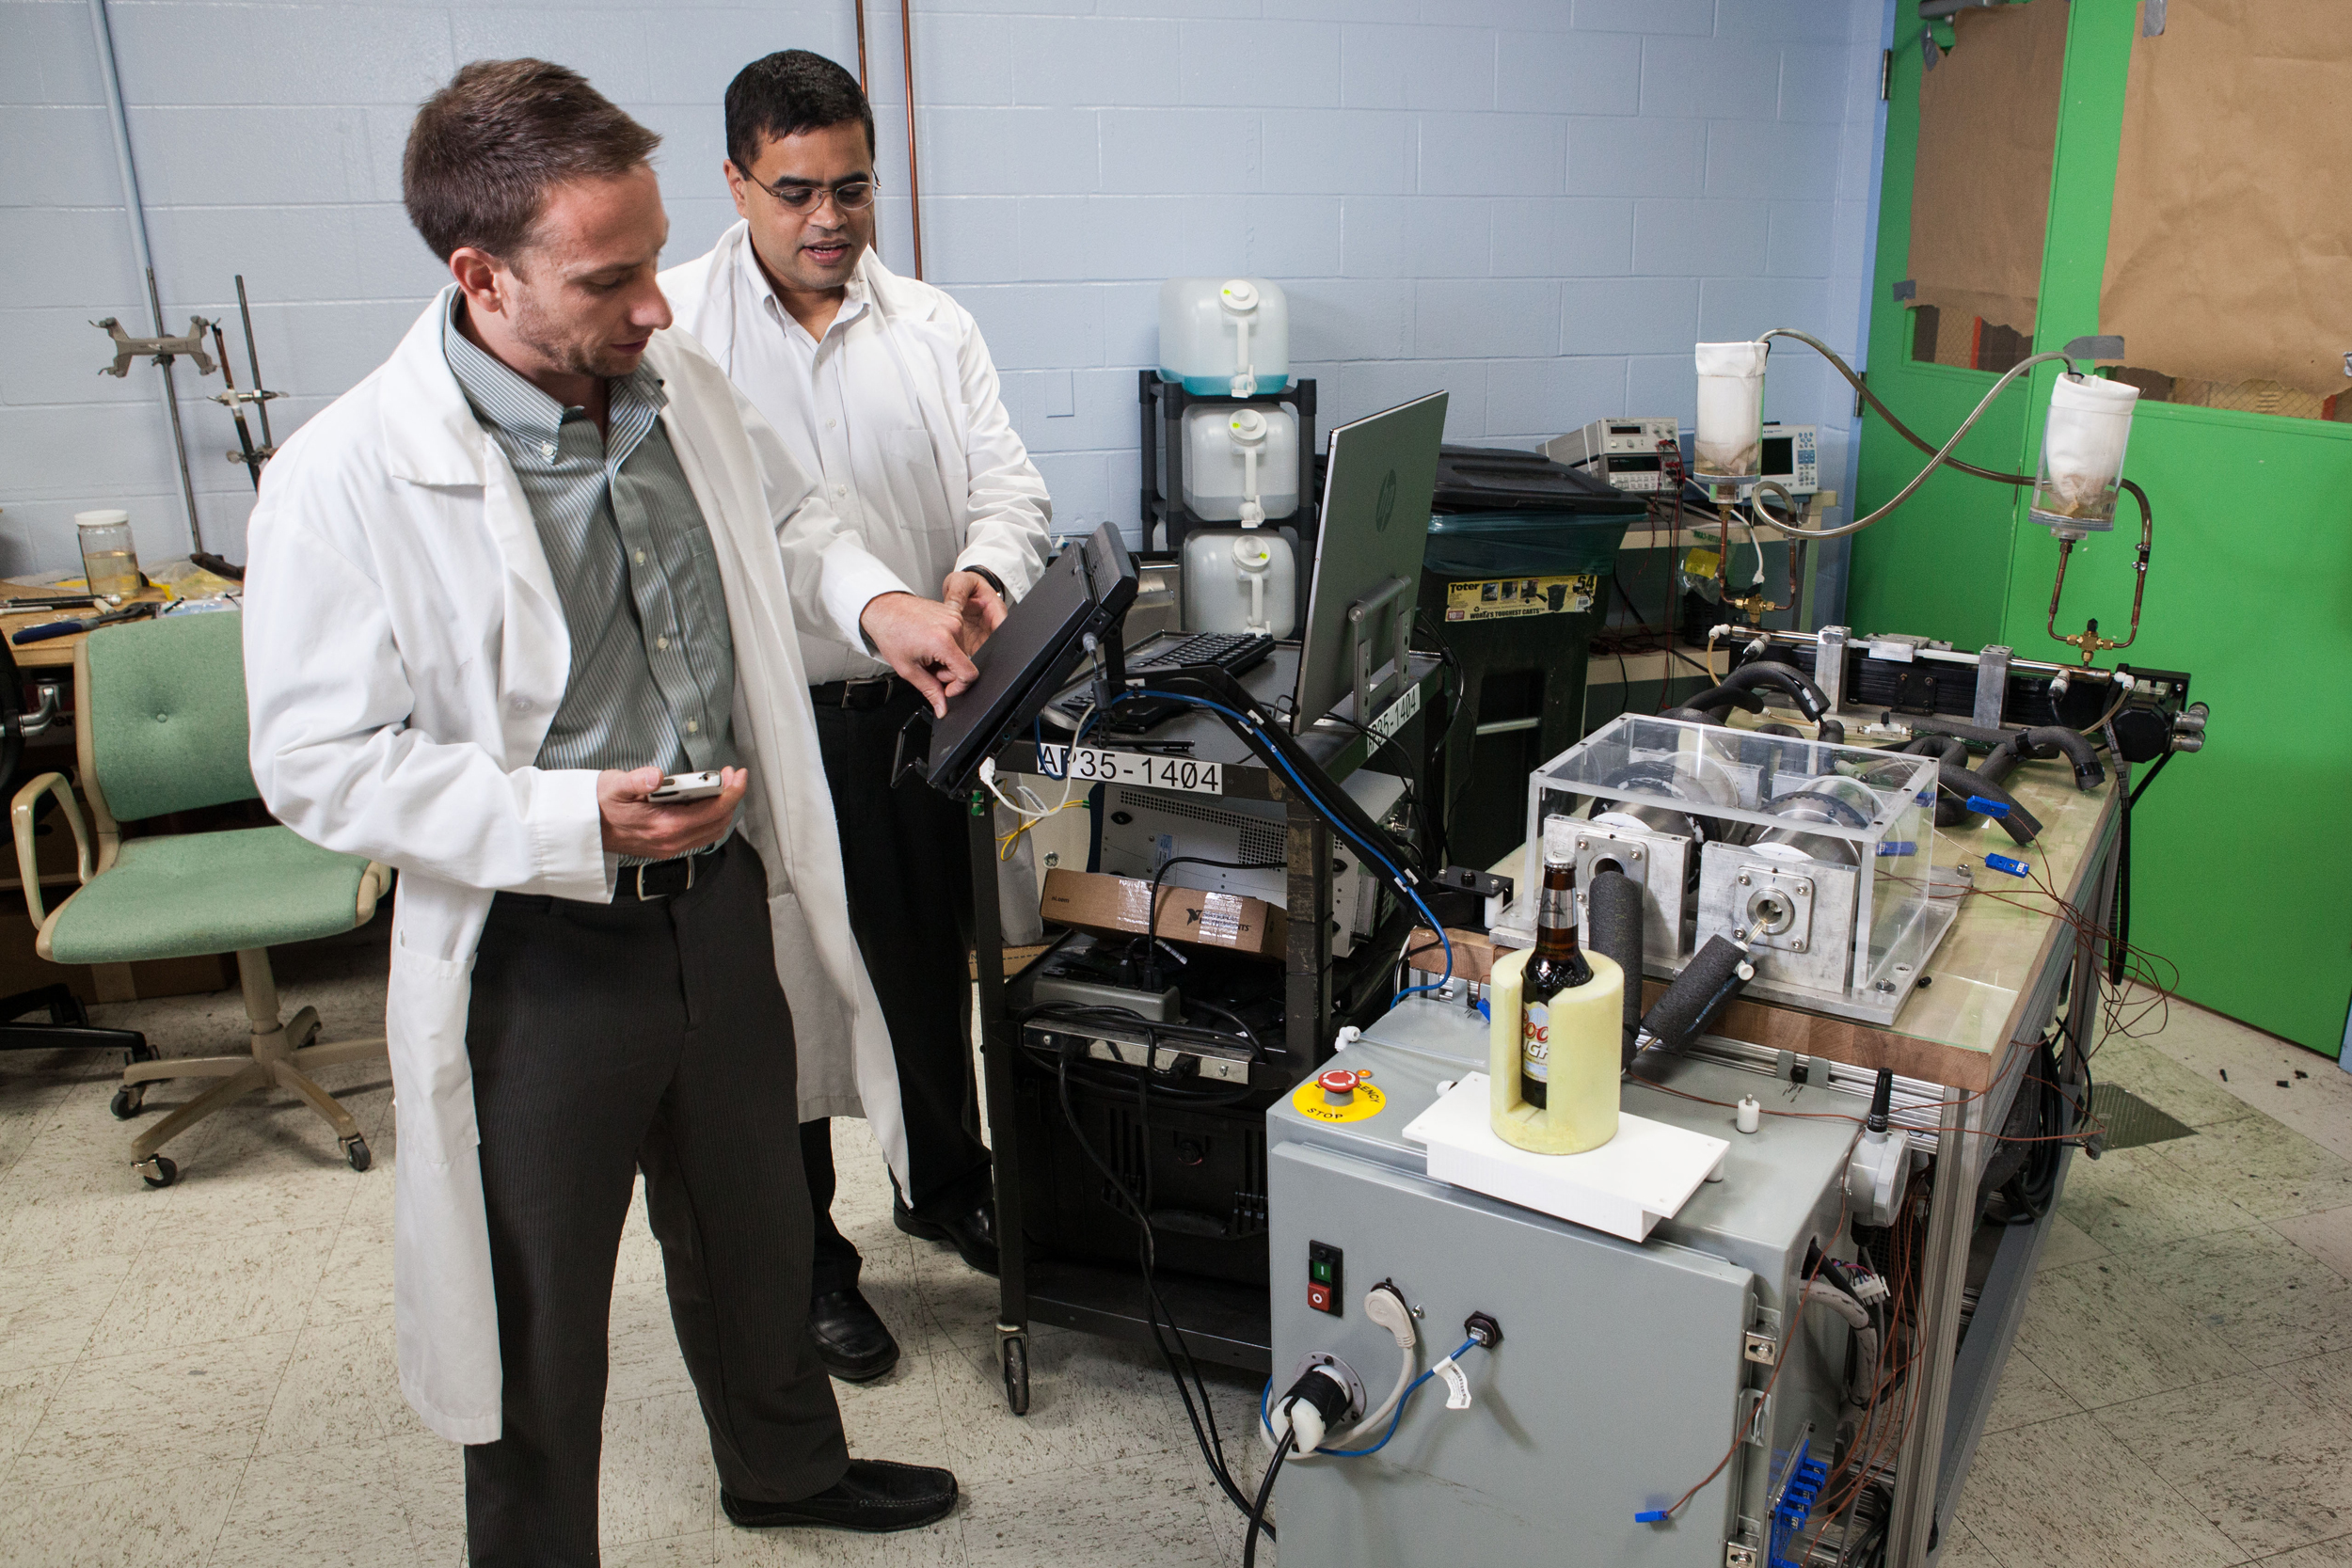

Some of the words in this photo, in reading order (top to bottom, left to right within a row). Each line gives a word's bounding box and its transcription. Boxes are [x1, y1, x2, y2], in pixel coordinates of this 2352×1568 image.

[1450, 583, 1480, 594] Toter
[1495, 609, 1521, 617] TOUGHEST
[1051, 895, 1070, 903] ni.com
[1307, 1107, 1343, 1119] STOP
